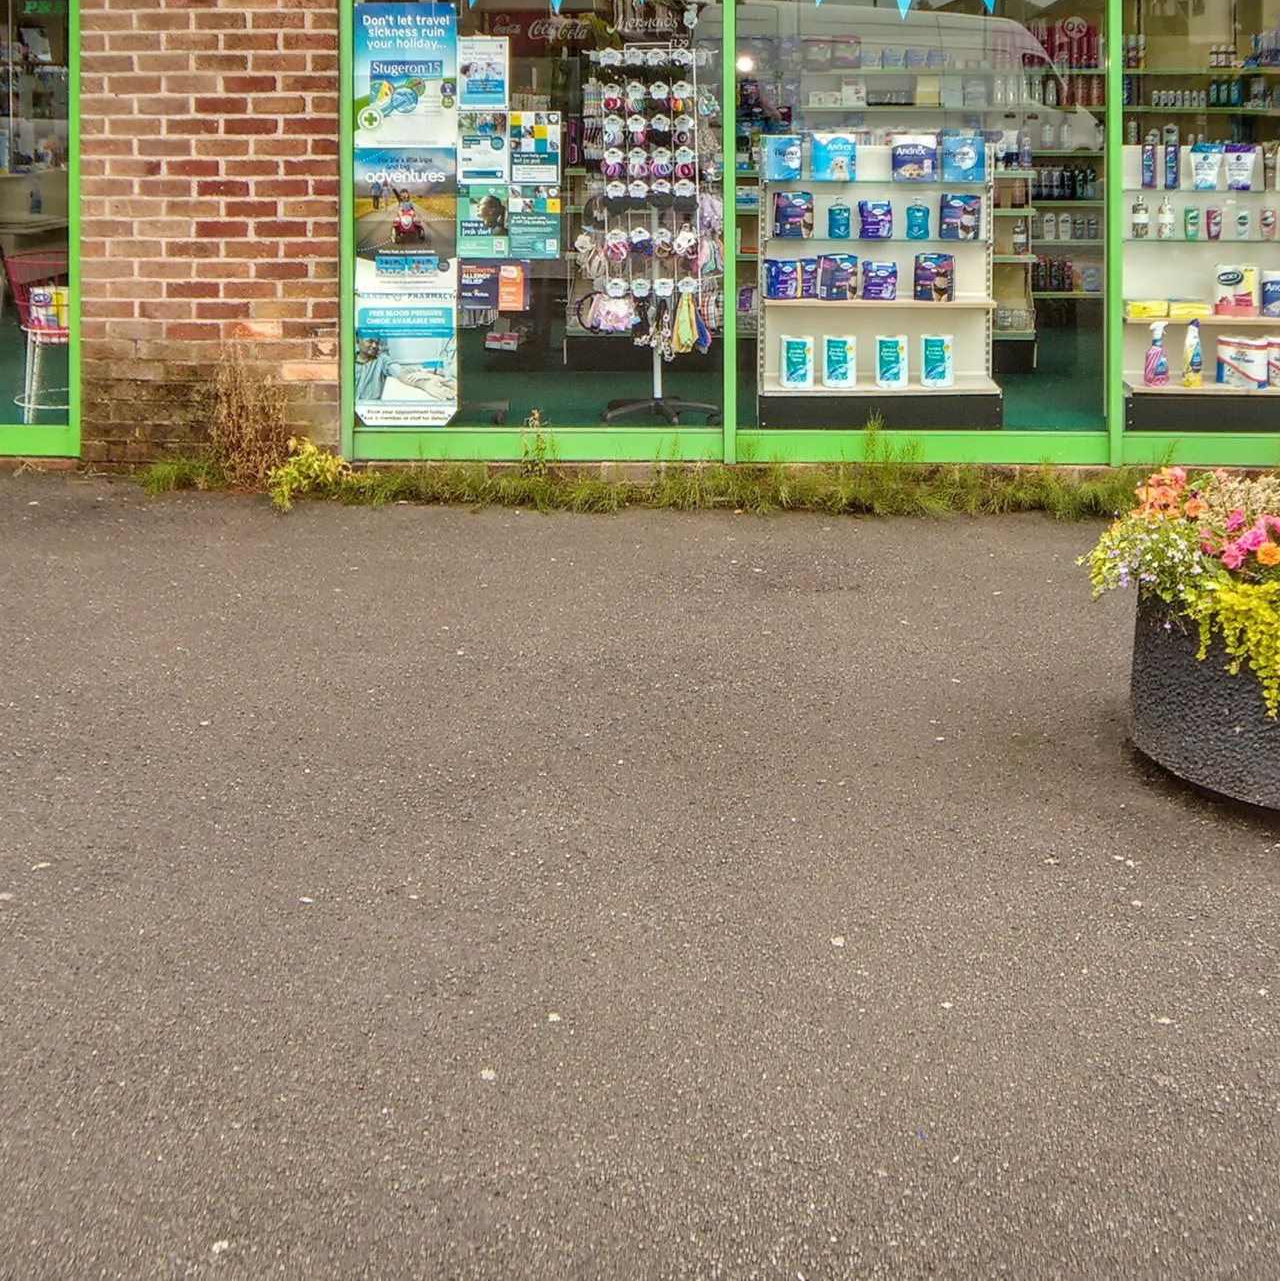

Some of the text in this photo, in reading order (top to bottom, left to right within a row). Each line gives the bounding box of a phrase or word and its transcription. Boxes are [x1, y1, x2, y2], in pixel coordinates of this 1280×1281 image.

[363, 15, 450, 26] Don't let travel
[368, 27, 445, 38] sickness ruin
[367, 38, 447, 51] your holiday...
[827, 143, 853, 152] Andrex
[896, 145, 926, 156] Andrex
[365, 169, 446, 183] adventures
[392, 317, 428, 325] AVAILABLE
